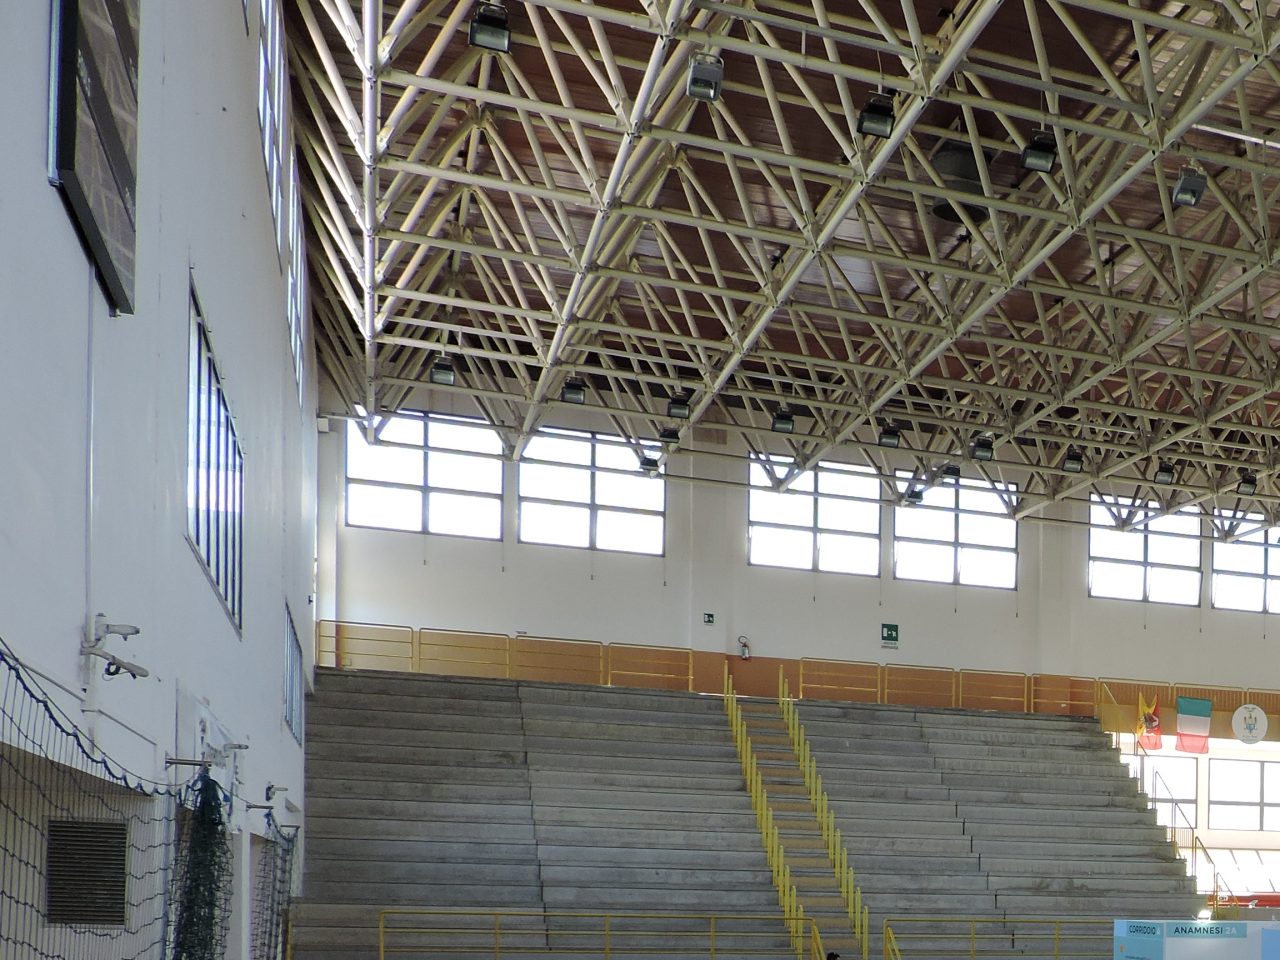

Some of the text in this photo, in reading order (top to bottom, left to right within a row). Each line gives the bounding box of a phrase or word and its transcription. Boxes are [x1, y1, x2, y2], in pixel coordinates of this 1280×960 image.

[1128, 925, 1156, 935] CORRIDOIO
[1173, 926, 1237, 935] ANAMNESI 2A
